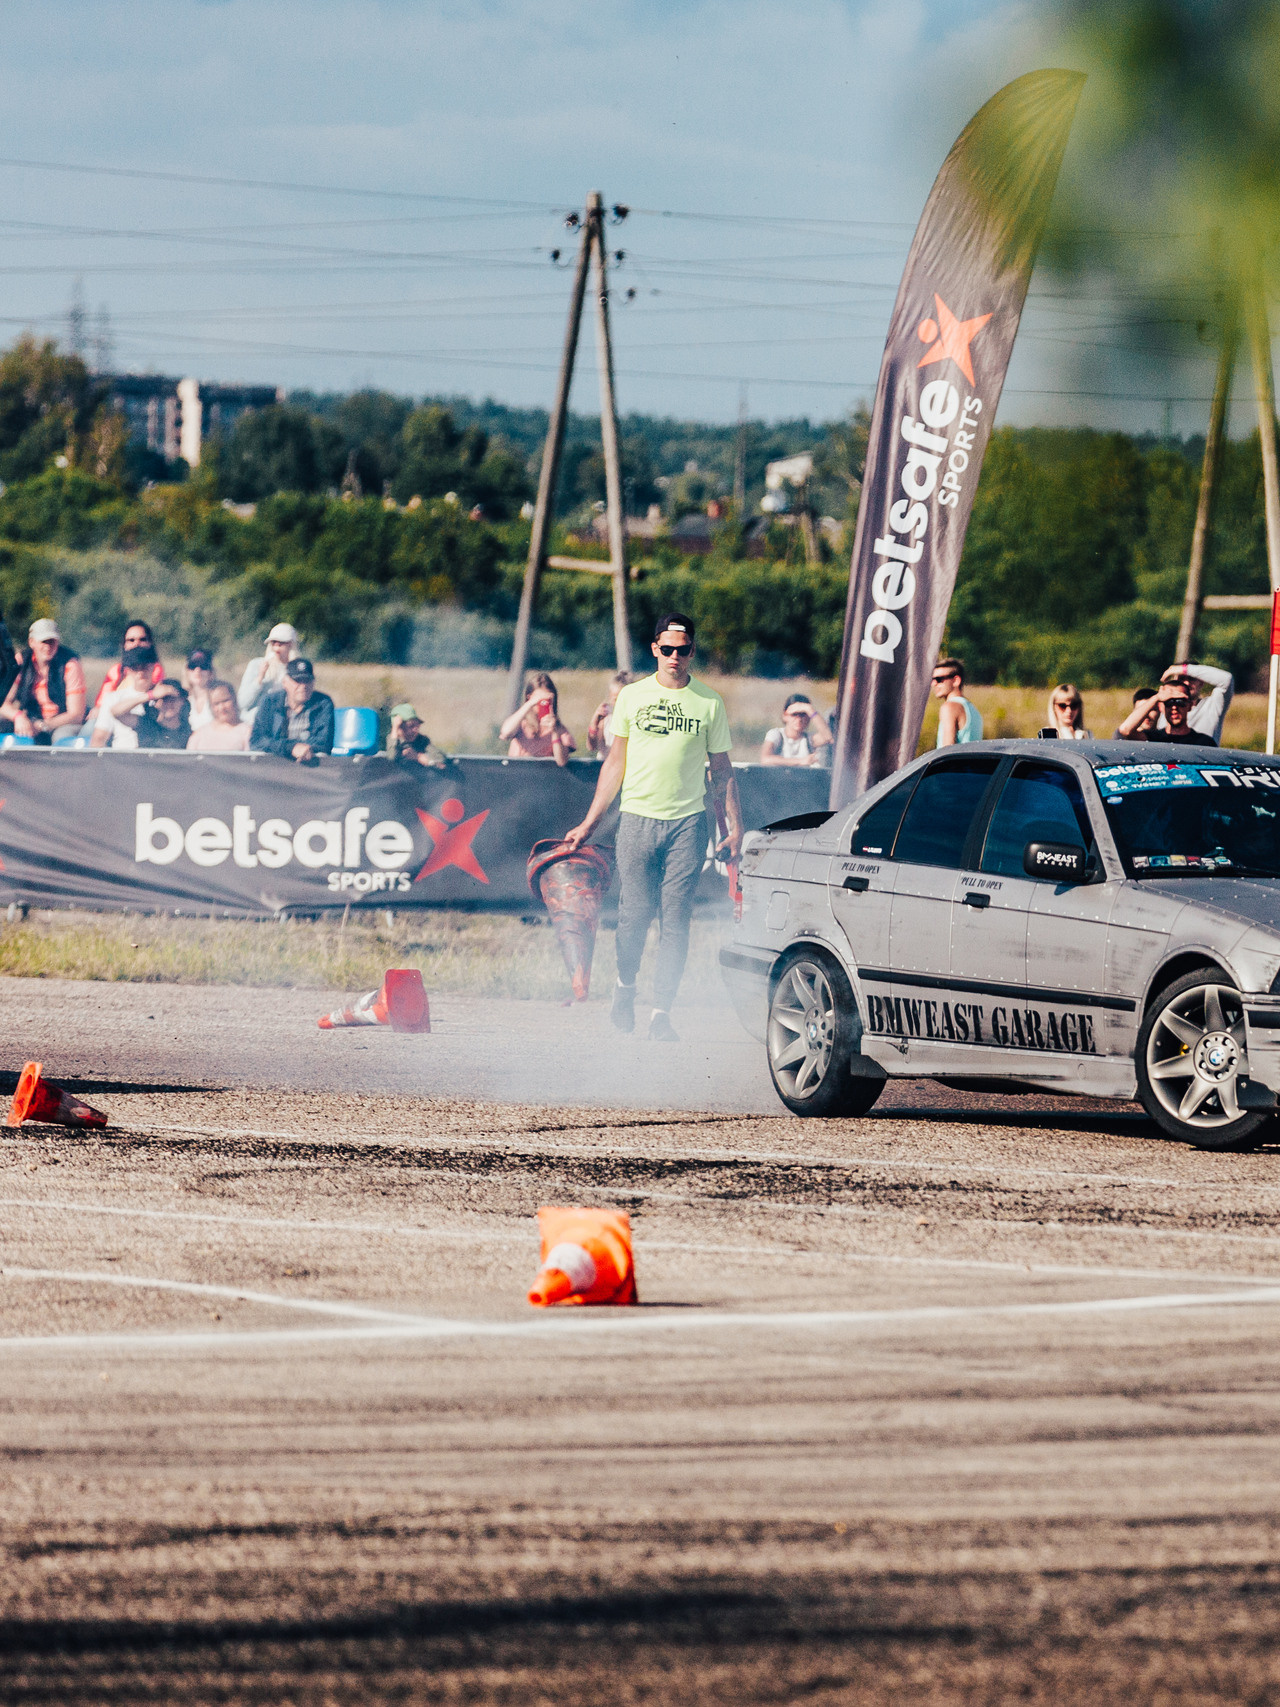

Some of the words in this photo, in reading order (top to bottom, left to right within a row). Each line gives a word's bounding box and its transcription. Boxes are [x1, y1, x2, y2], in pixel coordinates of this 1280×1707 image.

[937, 395, 983, 508] SPORTS
[860, 380, 960, 664] betsafe
[667, 702, 685, 717] ARE
[667, 716, 702, 737] DRIFT
[135, 802, 414, 869] betsafe
[327, 871, 412, 892] SPORTS
[866, 995, 984, 1043] BMWEAST
[991, 1006, 1097, 1053] GARAGE
